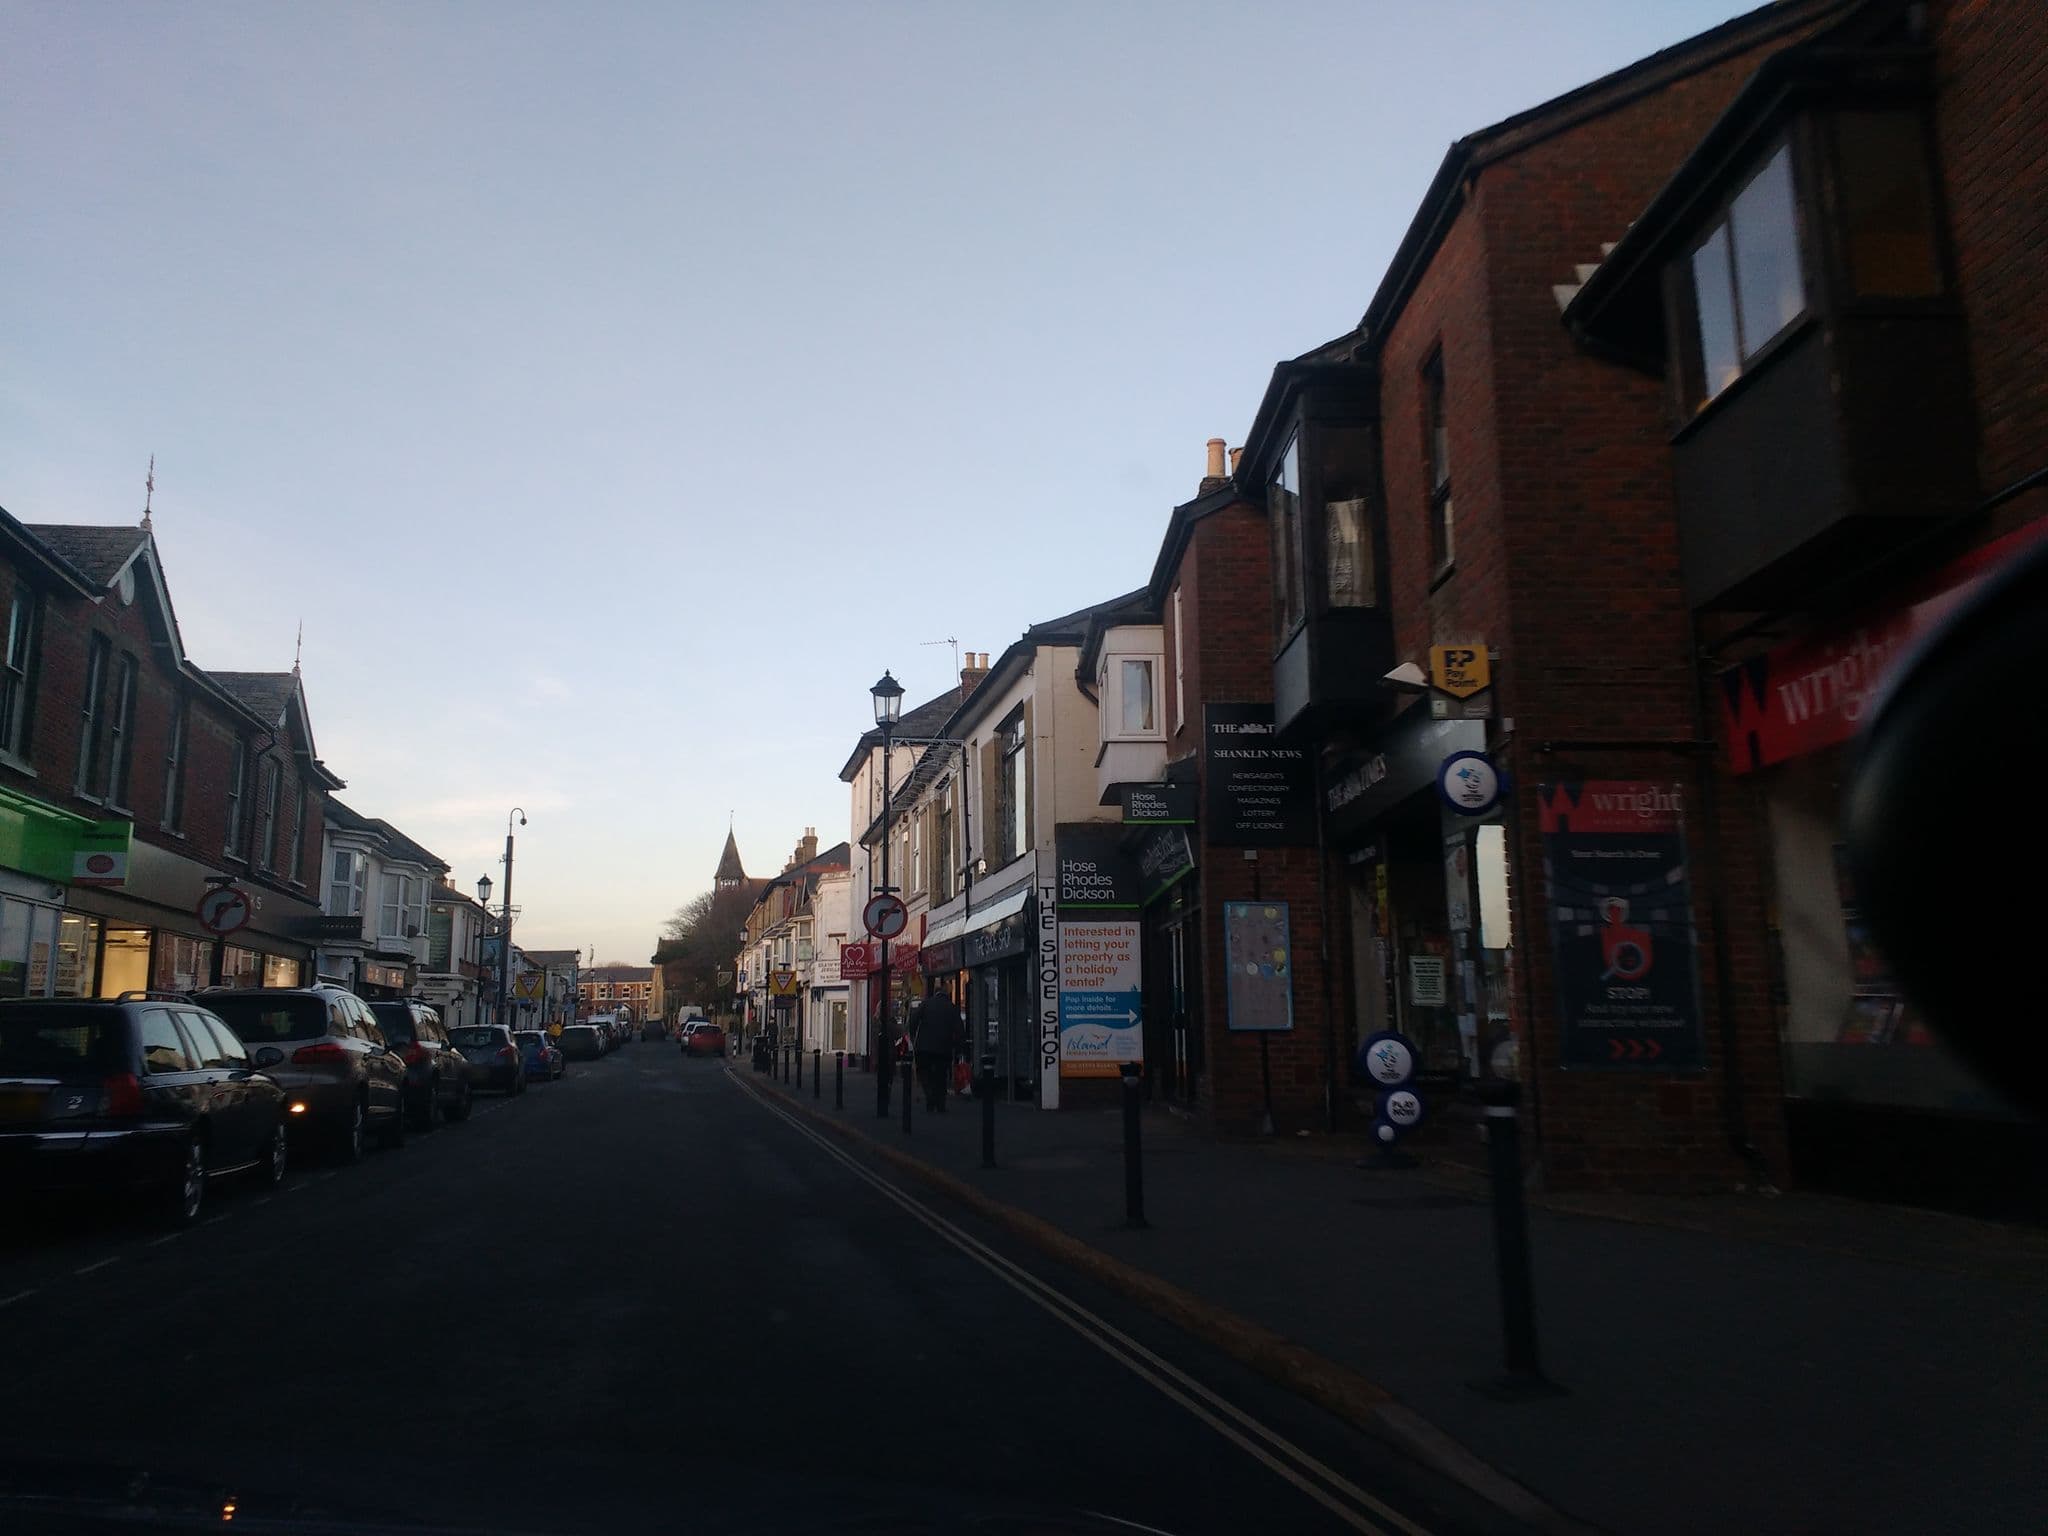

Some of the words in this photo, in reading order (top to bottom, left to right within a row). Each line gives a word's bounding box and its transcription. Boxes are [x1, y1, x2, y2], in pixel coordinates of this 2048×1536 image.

[1212, 723, 1238, 734] THE
[1214, 749, 1269, 759] SHANKLIN
[1271, 749, 1303, 759] NEWS
[1131, 792, 1156, 801] Hose
[1592, 785, 1682, 818] wright
[1131, 800, 1167, 809] Rhodes
[1131, 808, 1169, 817] Dickson
[1242, 809, 1276, 817] LOTTERY
[1062, 859, 1097, 872] Hose
[1062, 872, 1113, 886] Rhodes
[1062, 887, 1116, 900] Dickson
[1039, 886, 1055, 930] THE
[1064, 927, 1122, 937] Interested
[1125, 927, 1136, 937] in
[1064, 939, 1101, 951] letting
[1104, 941, 1130, 951] your
[1065, 952, 1113, 964] property
[1117, 953, 1131, 962] as
[1041, 939, 1058, 999] SHOE
[1065, 966, 1073, 974] a
[1076, 964, 1118, 976] holiday
[1065, 977, 1105, 988] rental?
[1065, 996, 1080, 1004] Pop
[1042, 1010, 1059, 1070] SHOP
